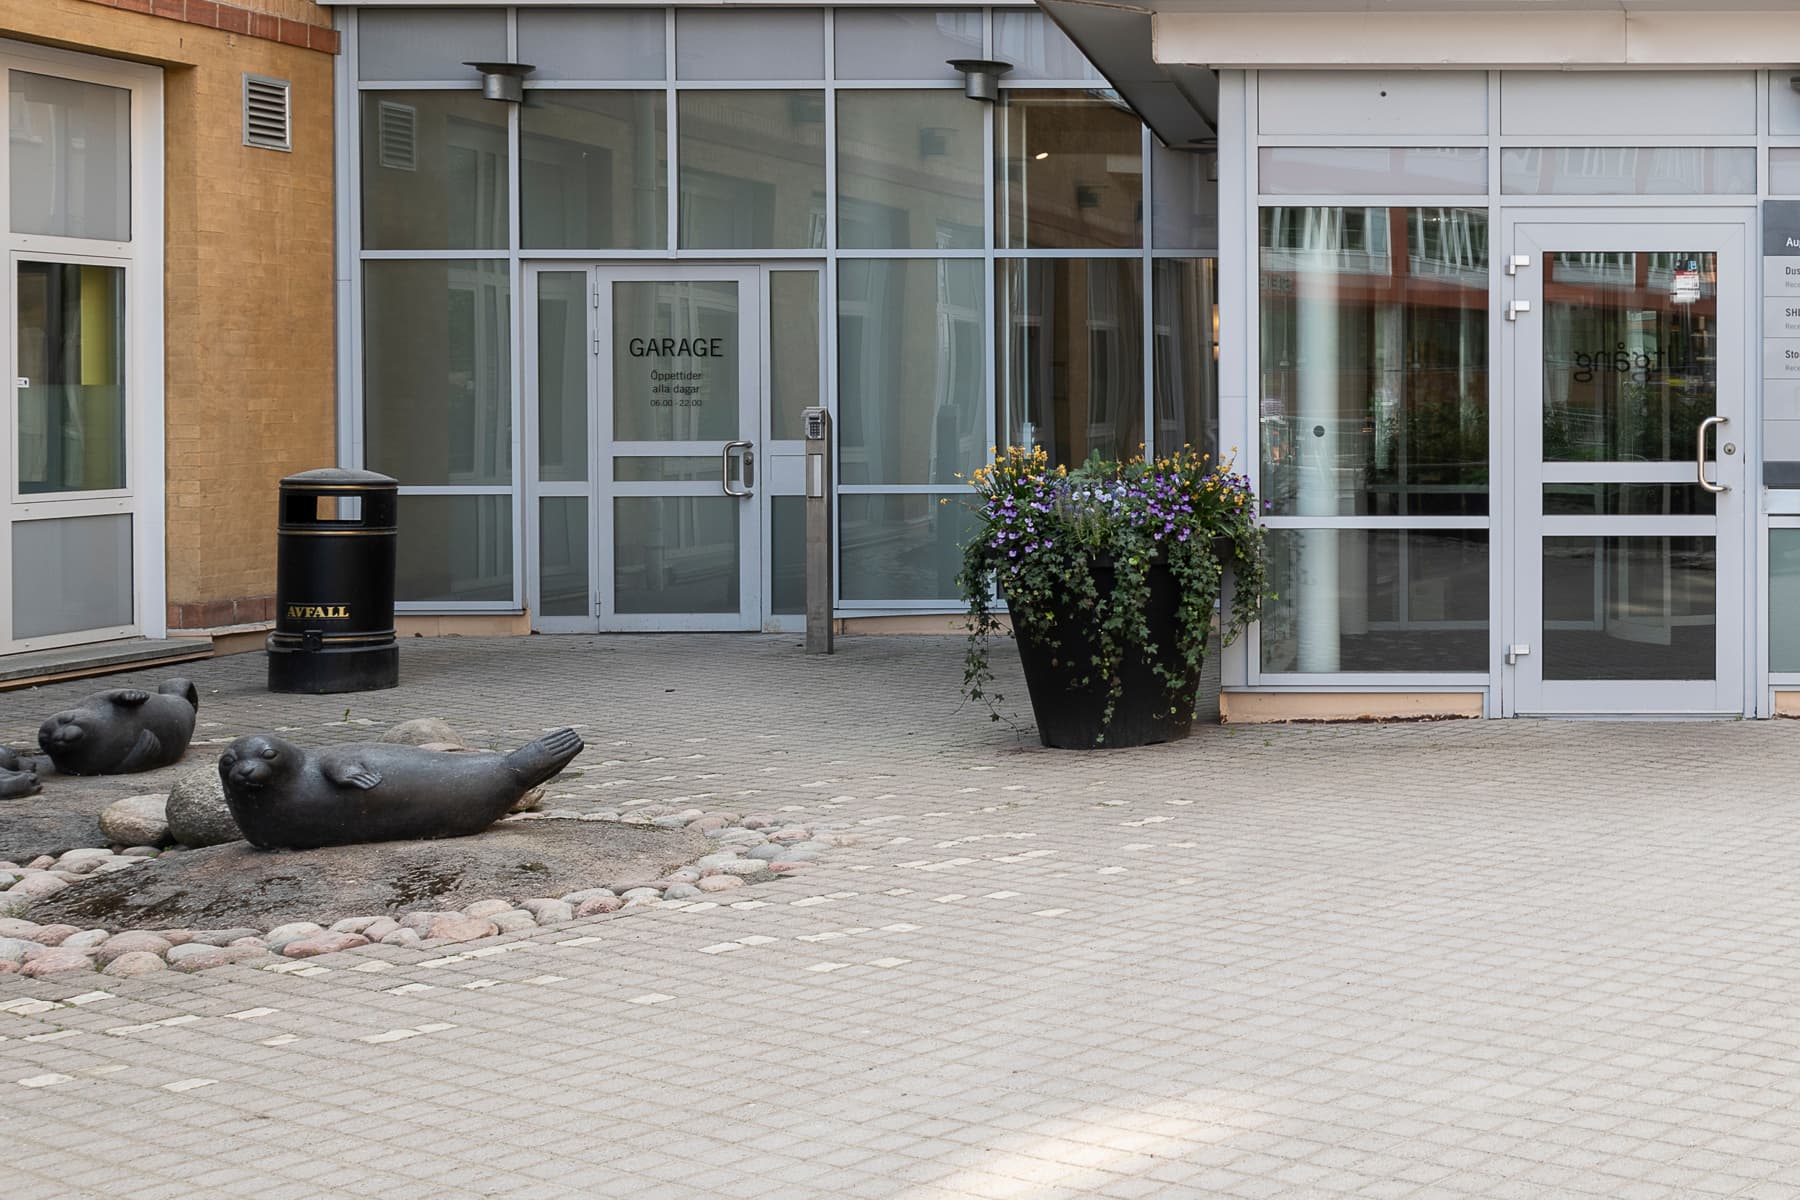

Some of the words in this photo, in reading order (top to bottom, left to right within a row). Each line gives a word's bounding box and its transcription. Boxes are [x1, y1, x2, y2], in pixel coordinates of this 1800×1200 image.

[629, 337, 724, 358] GARAGE
[650, 369, 703, 382] Öppettider
[651, 383, 671, 393] alla
[673, 383, 700, 396] dagar
[287, 606, 351, 618] AVFALL
